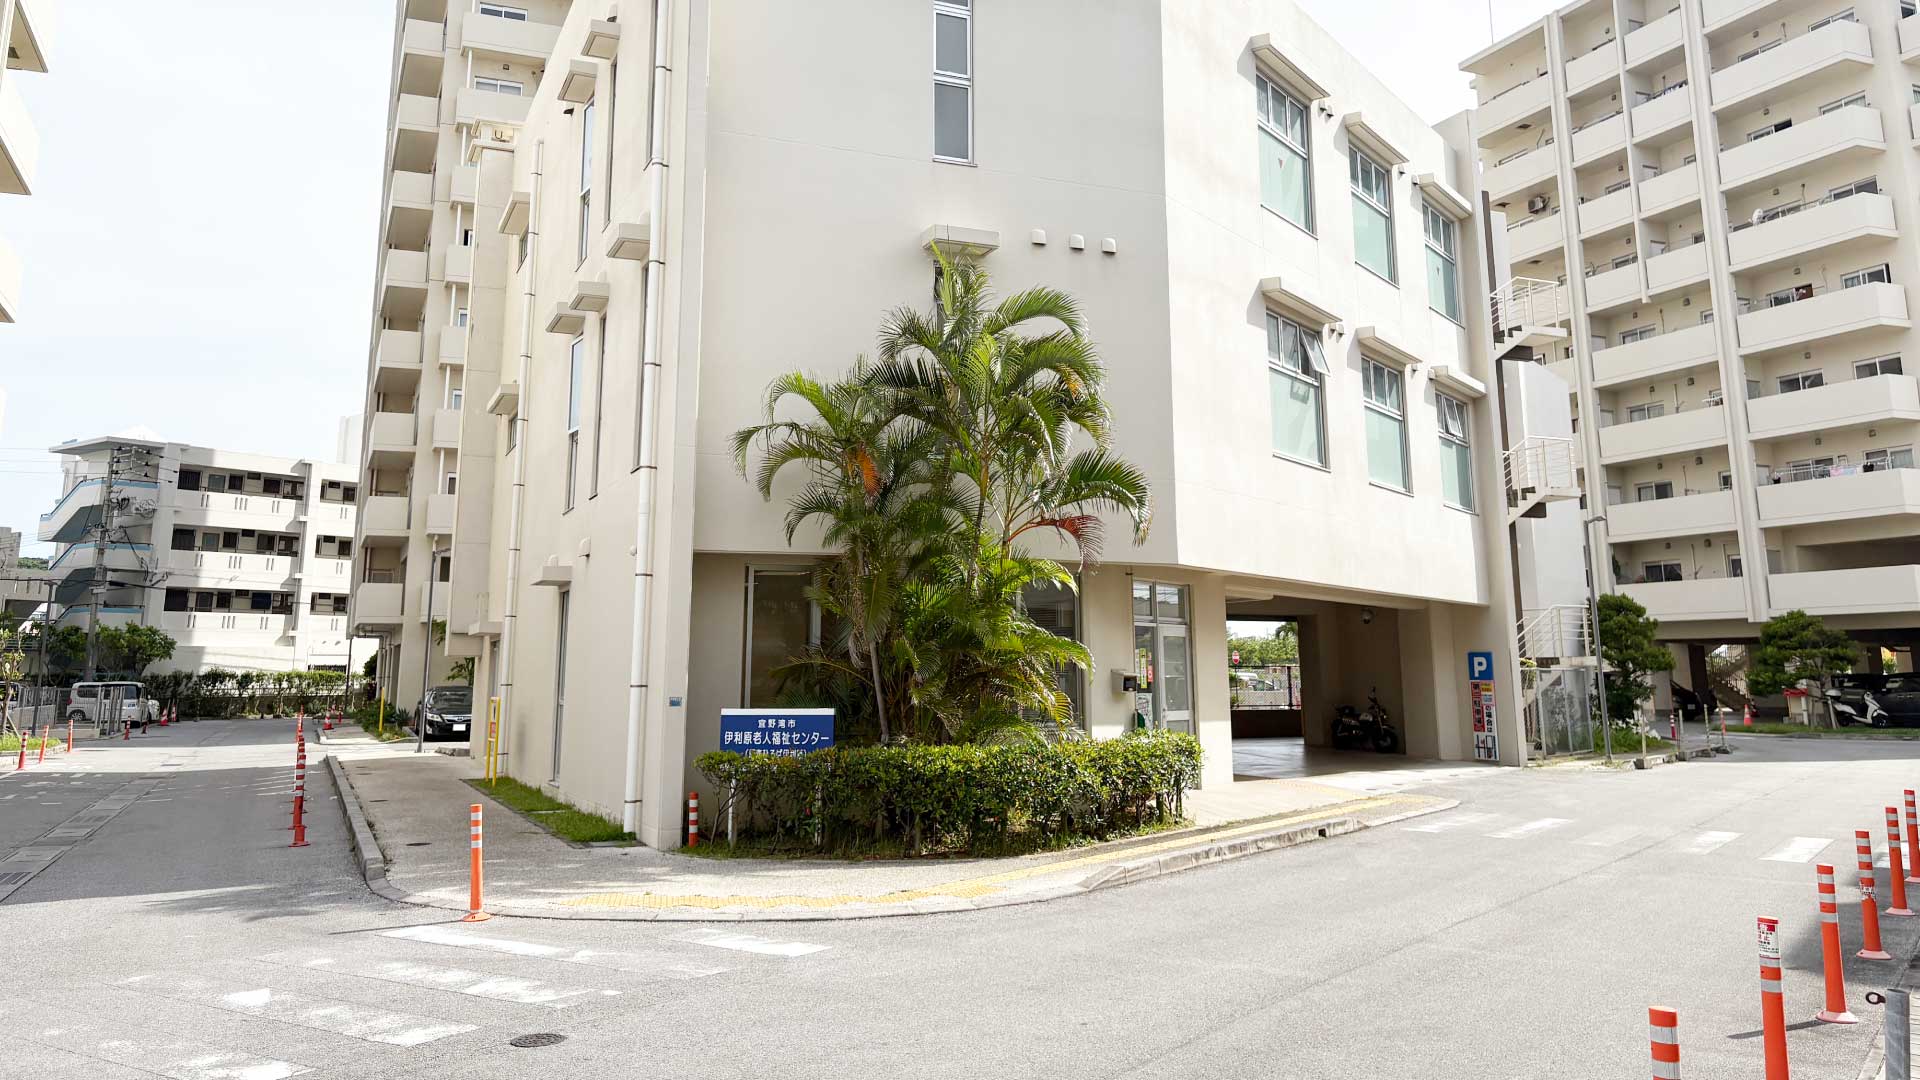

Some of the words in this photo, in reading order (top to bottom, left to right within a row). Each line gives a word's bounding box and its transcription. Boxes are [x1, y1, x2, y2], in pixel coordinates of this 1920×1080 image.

[1473, 656, 1487, 677] P
[757, 719, 796, 729] 宜野湾市
[724, 731, 830, 745] 伊利原老人福祉センター
